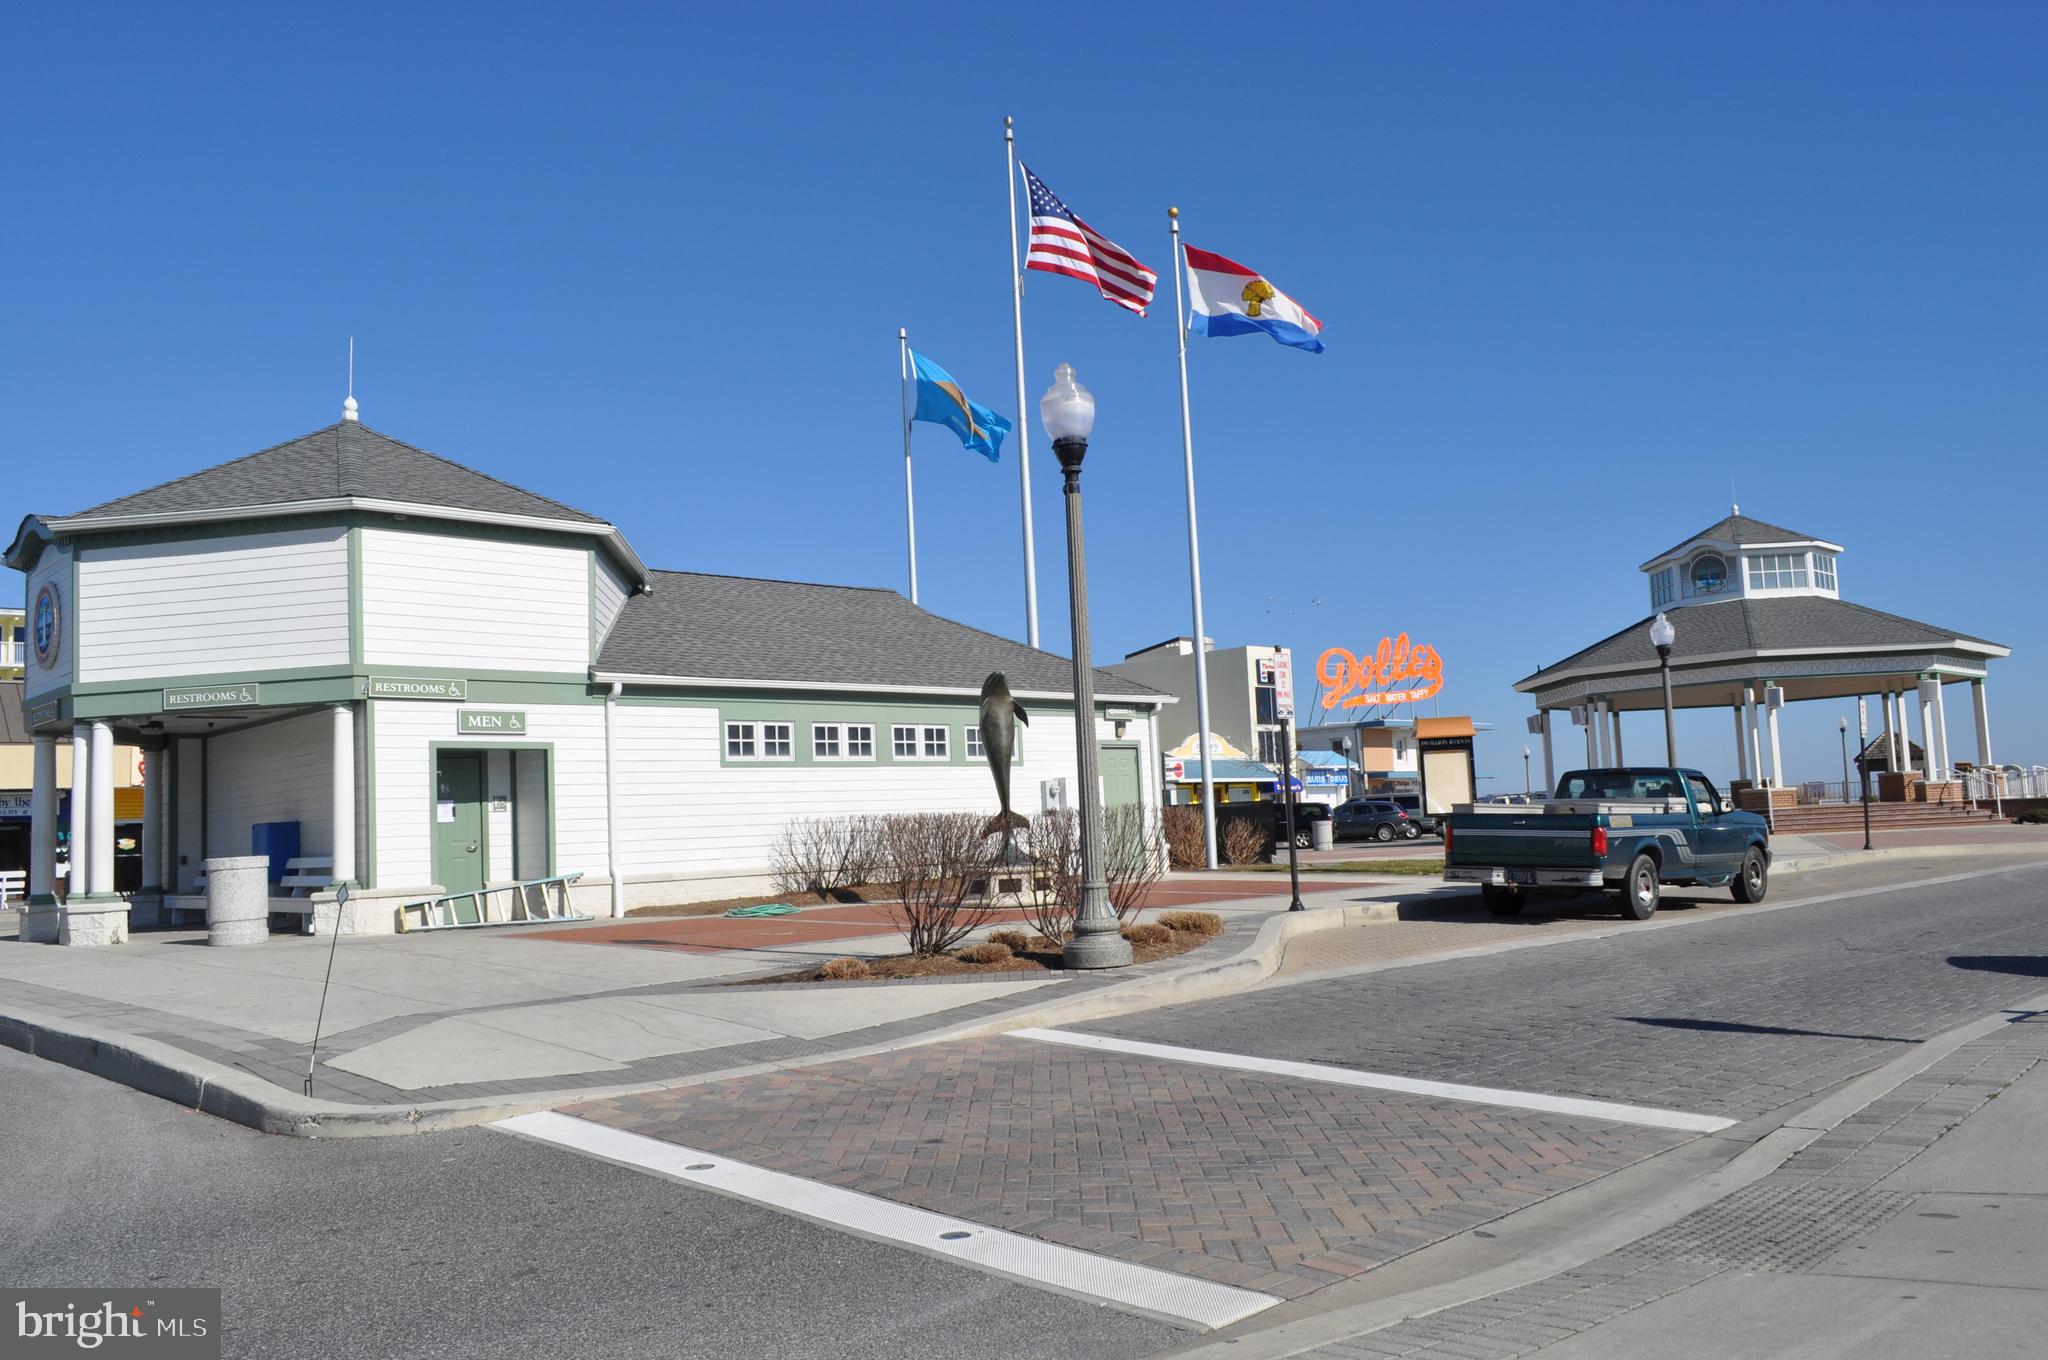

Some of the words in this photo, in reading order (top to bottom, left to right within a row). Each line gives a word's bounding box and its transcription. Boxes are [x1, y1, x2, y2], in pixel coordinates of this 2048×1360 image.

[375, 682, 445, 694] RESTROOMS
[169, 691, 237, 704] RESTROOMS
[1364, 694, 1380, 704] SALT
[1385, 693, 1406, 702] WATER
[1410, 689, 1429, 699] TAFFY
[468, 715, 502, 727] MEN
